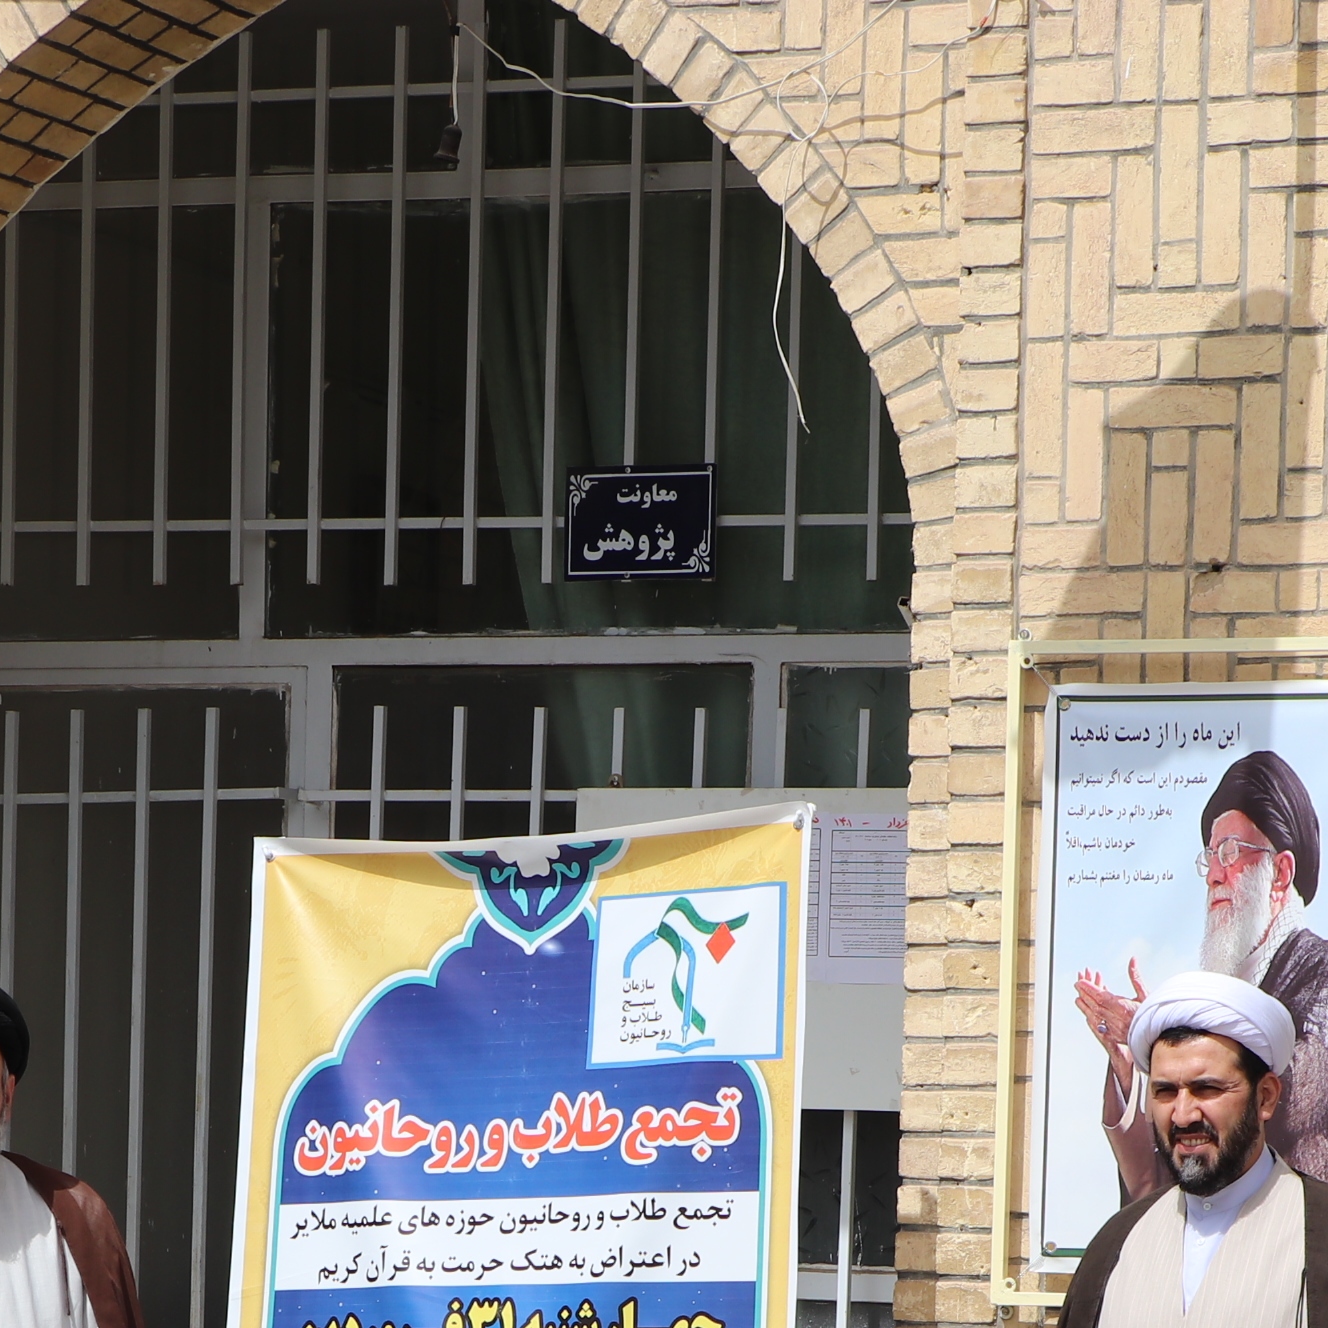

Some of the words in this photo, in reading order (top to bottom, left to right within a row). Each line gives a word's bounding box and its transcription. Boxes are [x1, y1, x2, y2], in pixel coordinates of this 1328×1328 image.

[616, 483, 678, 508] معاونت
[583, 523, 676, 561] پژوهش
[1070, 723, 1109, 748] ندهید
[1114, 725, 1151, 742] دست
[1155, 722, 1169, 748] از
[1174, 721, 1187, 748] را
[1192, 722, 1213, 742] ماه
[1217, 721, 1242, 750] این
[1105, 767, 1121, 788] اگر
[1123, 769, 1135, 785] که
[1137, 771, 1156, 784] است
[1157, 772, 1172, 789] این
[1173, 771, 1208, 792] مقصودم
[1067, 803, 1096, 820] مراقبت
[1097, 804, 1114, 817] حال
[1116, 807, 1127, 820] در
[1104, 837, 1136, 853] خودمان
[1067, 869, 1098, 888] بشماریم
[1099, 869, 1120, 888] مغتنم
[1123, 869, 1131, 884] را
[1133, 869, 1159, 884] رمضان
[1161, 869, 1174, 881] ماه
[622, 979, 655, 994] سازمان
[621, 1016, 627, 1027] و
[630, 1011, 662, 1027] طلاب
[619, 1027, 671, 1044] روحانیون
[295, 1098, 478, 1175] روحانیون
[512, 1092, 622, 1168] طلاب
[622, 1089, 742, 1163] تجمع
[480, 1119, 508, 1171] و
[341, 1205, 392, 1233] علمیه
[398, 1206, 439, 1236] های
[499, 1202, 592, 1234] روحانیون
[596, 1210, 606, 1230] و
[609, 1198, 666, 1226] طلاب
[673, 1199, 734, 1229] تجمع
[290, 1210, 337, 1239] ملایر
[445, 1212, 494, 1235] حوزه
[318, 1252, 363, 1285] کریم
[365, 1245, 411, 1282] قرآن
[416, 1260, 436, 1276] به
[441, 1257, 504, 1282] حرمت
[510, 1249, 563, 1271] هتک
[570, 1258, 587, 1276] به
[590, 1247, 671, 1279] اعتراض
[675, 1254, 701, 1277] در
